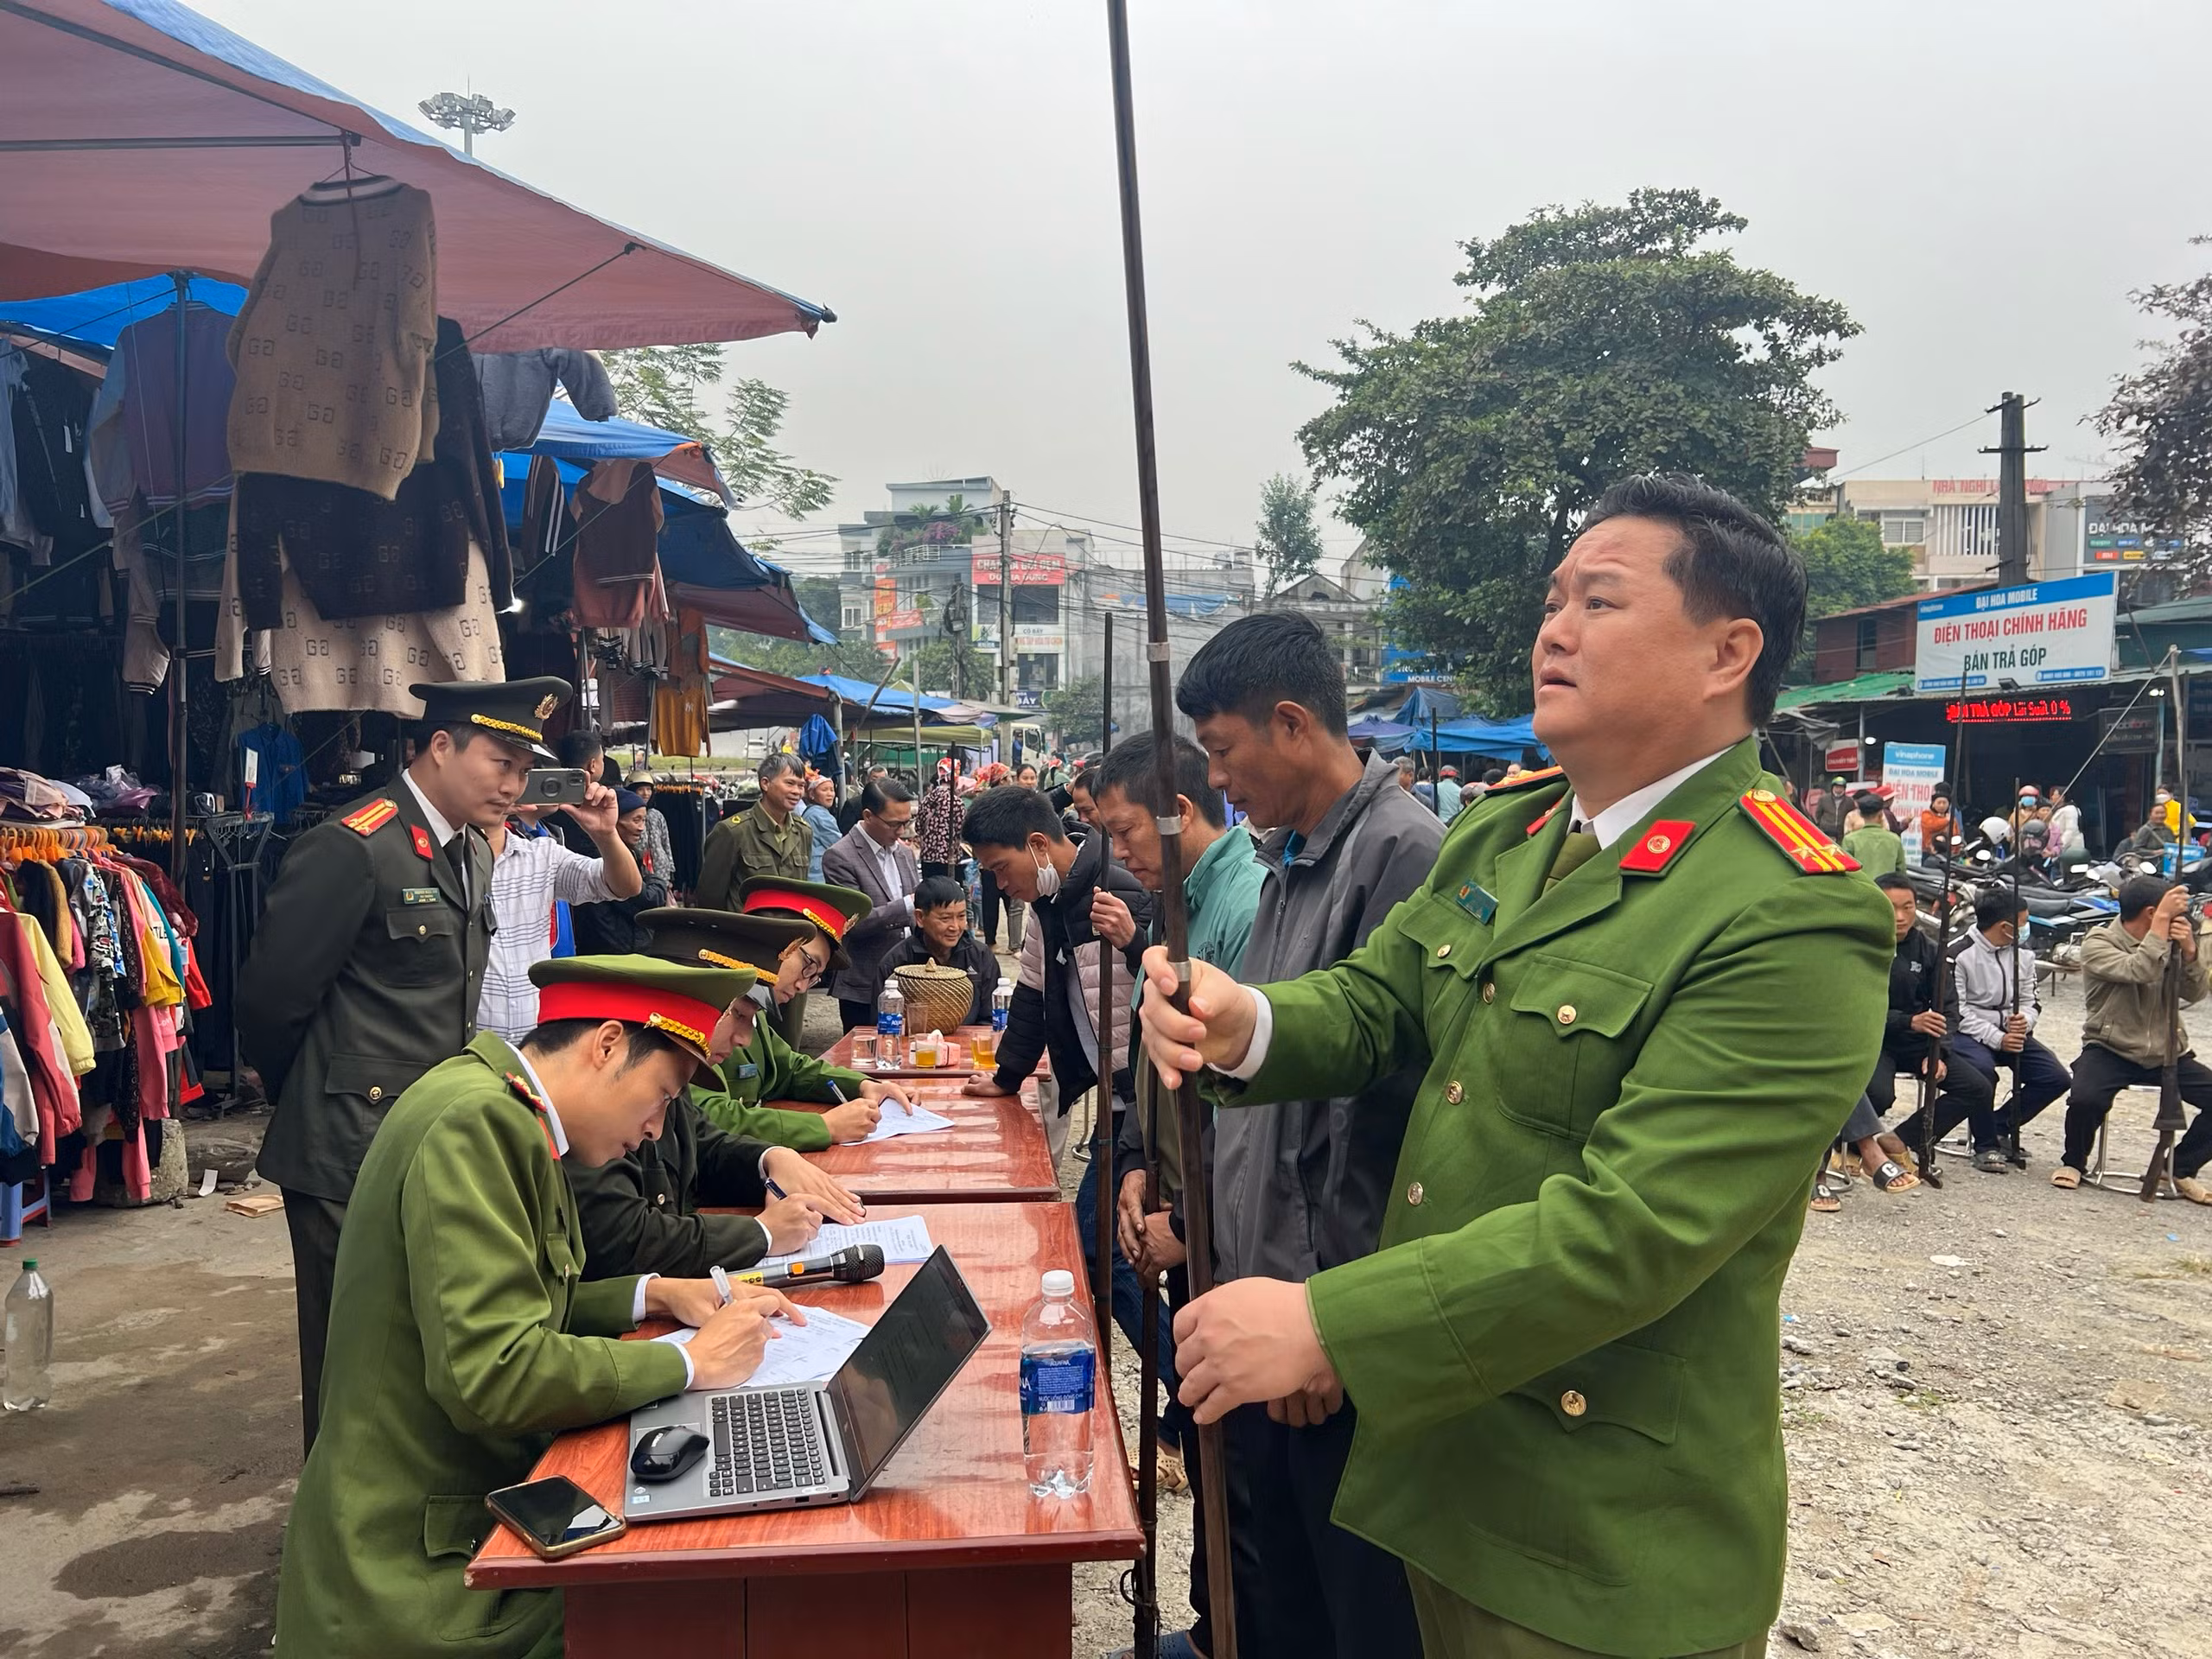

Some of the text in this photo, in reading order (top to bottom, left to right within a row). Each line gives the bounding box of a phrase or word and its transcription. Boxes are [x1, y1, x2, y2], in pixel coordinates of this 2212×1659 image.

[1975, 588, 2038, 612] ĐẠI HOA MOBILE
[1934, 607, 2088, 647] ĐIỆN THOẠI CHÍNH HÃNG
[1963, 644, 2047, 672] BÁN TRẢ GÓP
[1407, 675, 1435, 683] MOBILE
[1895, 749, 1936, 760] vinaphone
